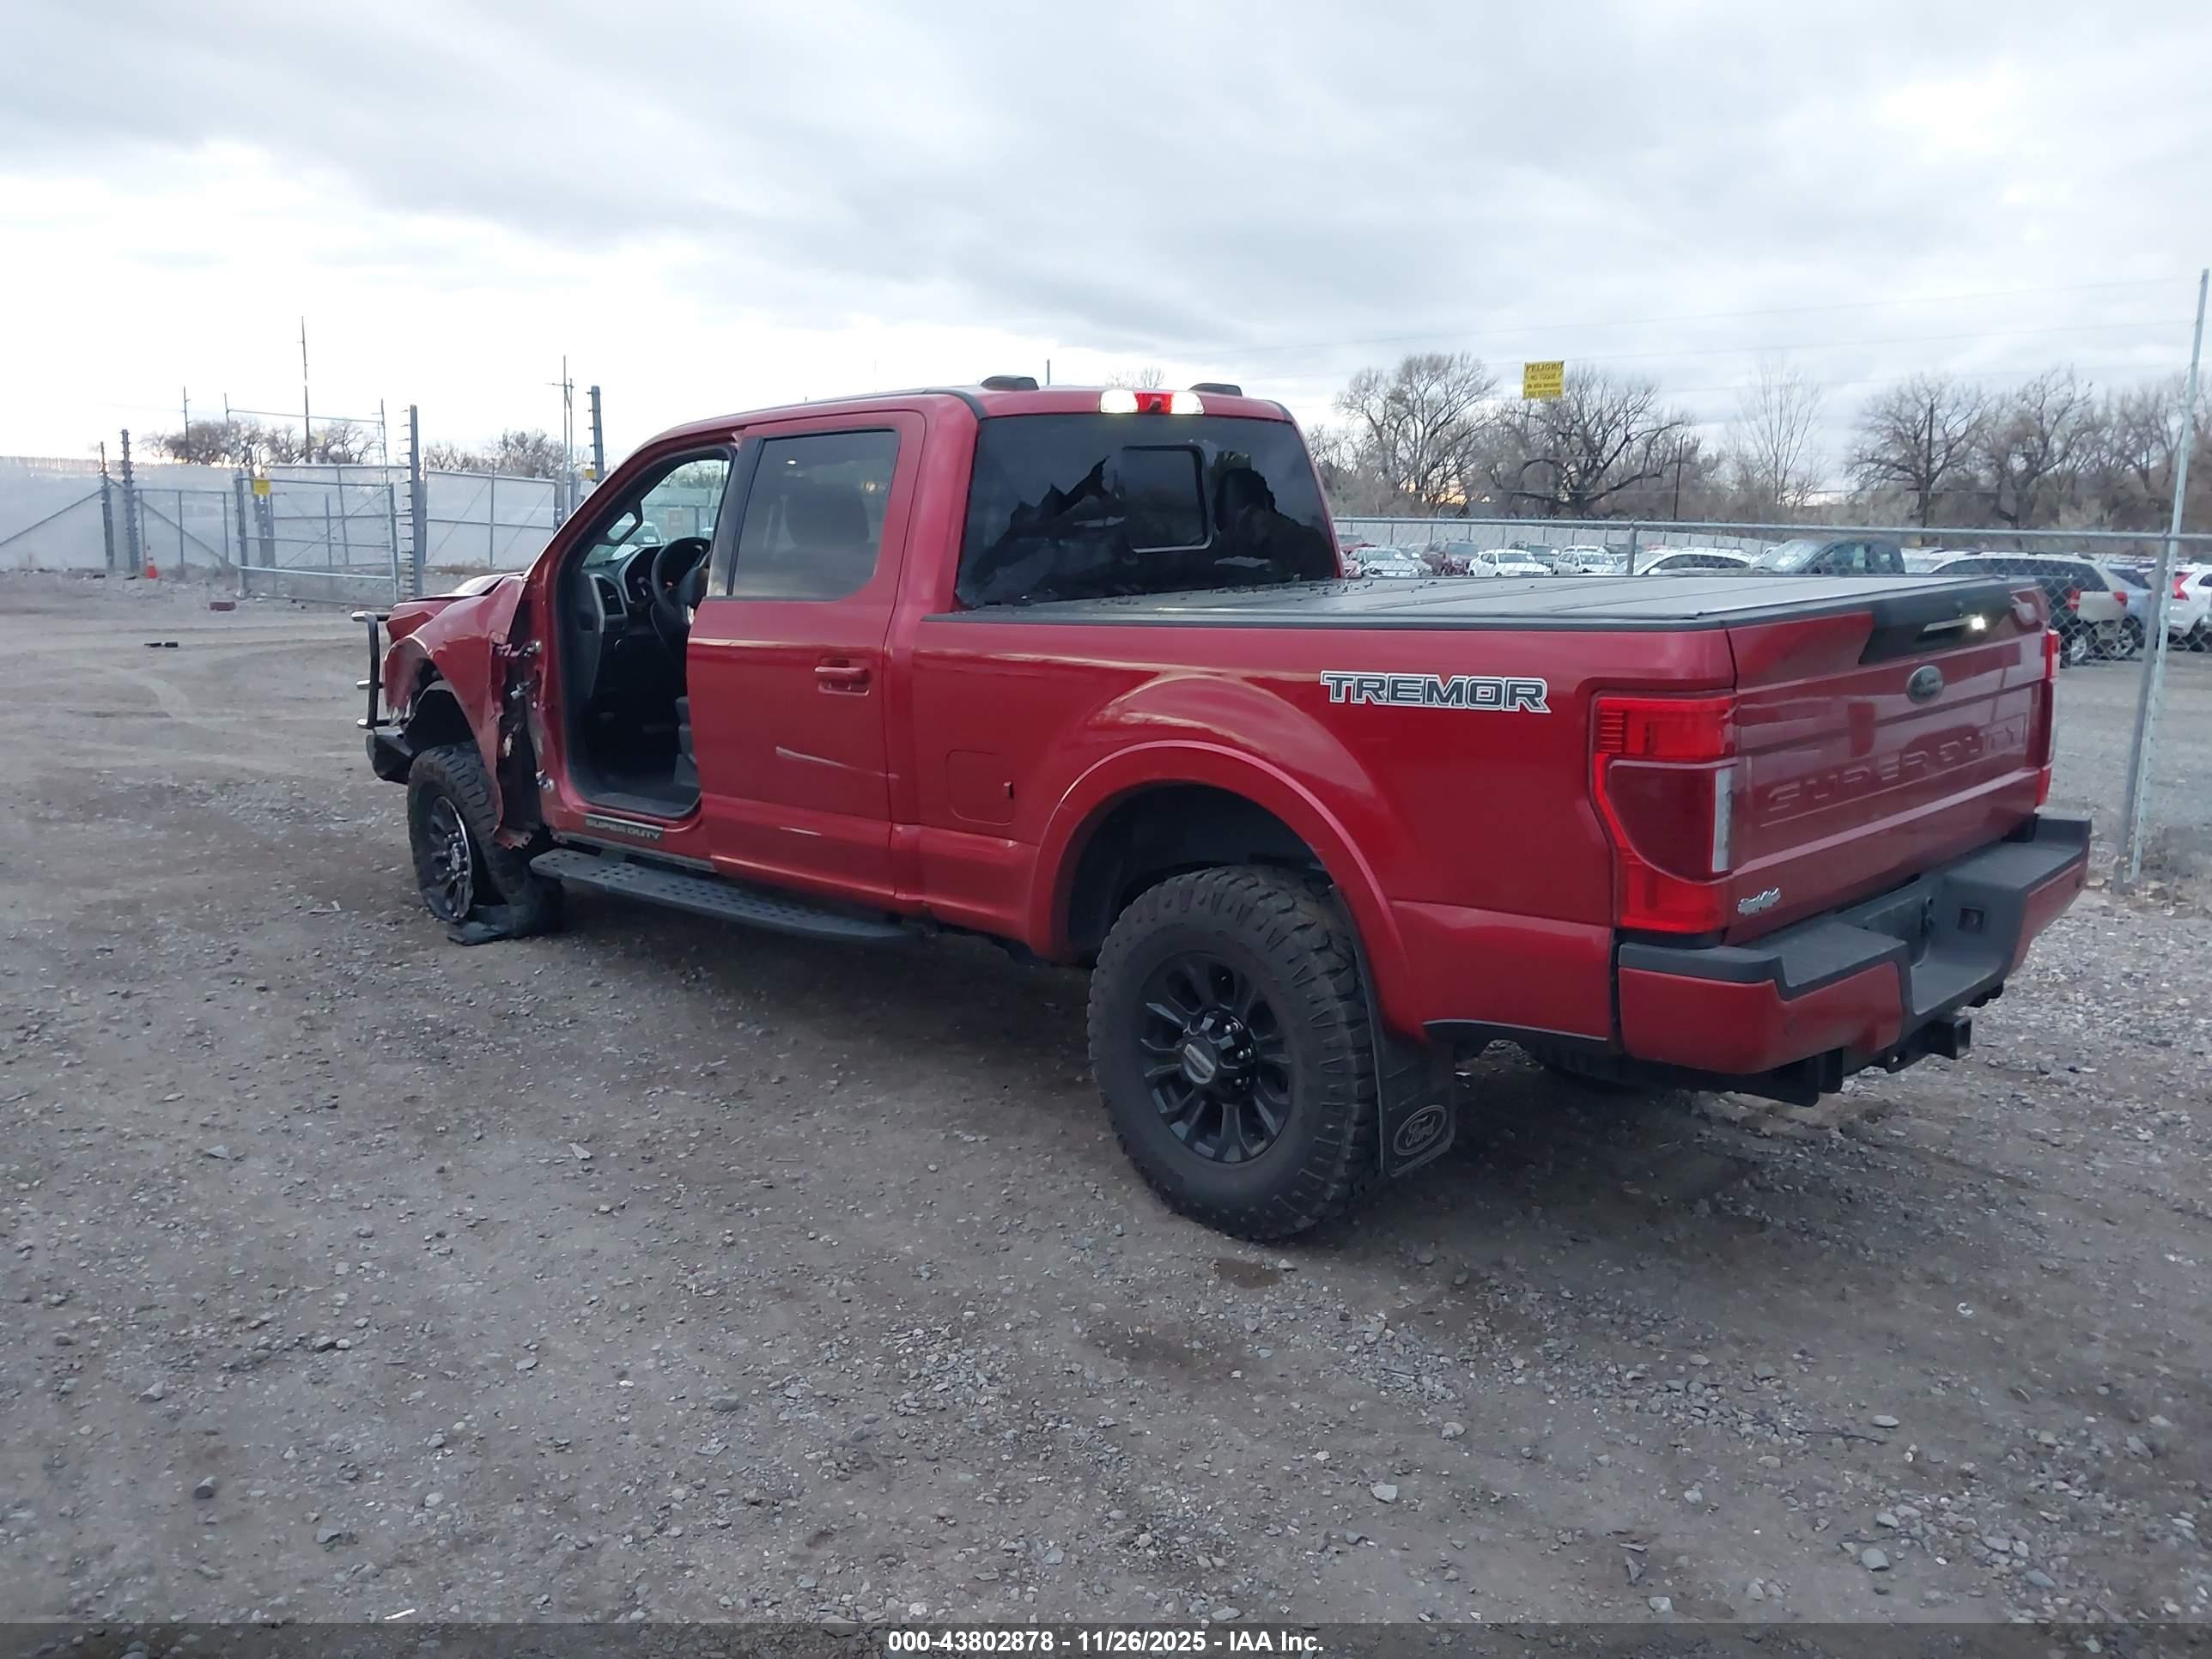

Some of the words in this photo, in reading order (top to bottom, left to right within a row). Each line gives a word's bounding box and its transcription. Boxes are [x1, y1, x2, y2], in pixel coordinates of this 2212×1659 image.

[1525, 362, 1563, 372] PELIGRO
[1320, 670, 1552, 714] TREMOR
[1767, 749, 1929, 811] SUPER
[627, 826, 660, 840] DUTY
